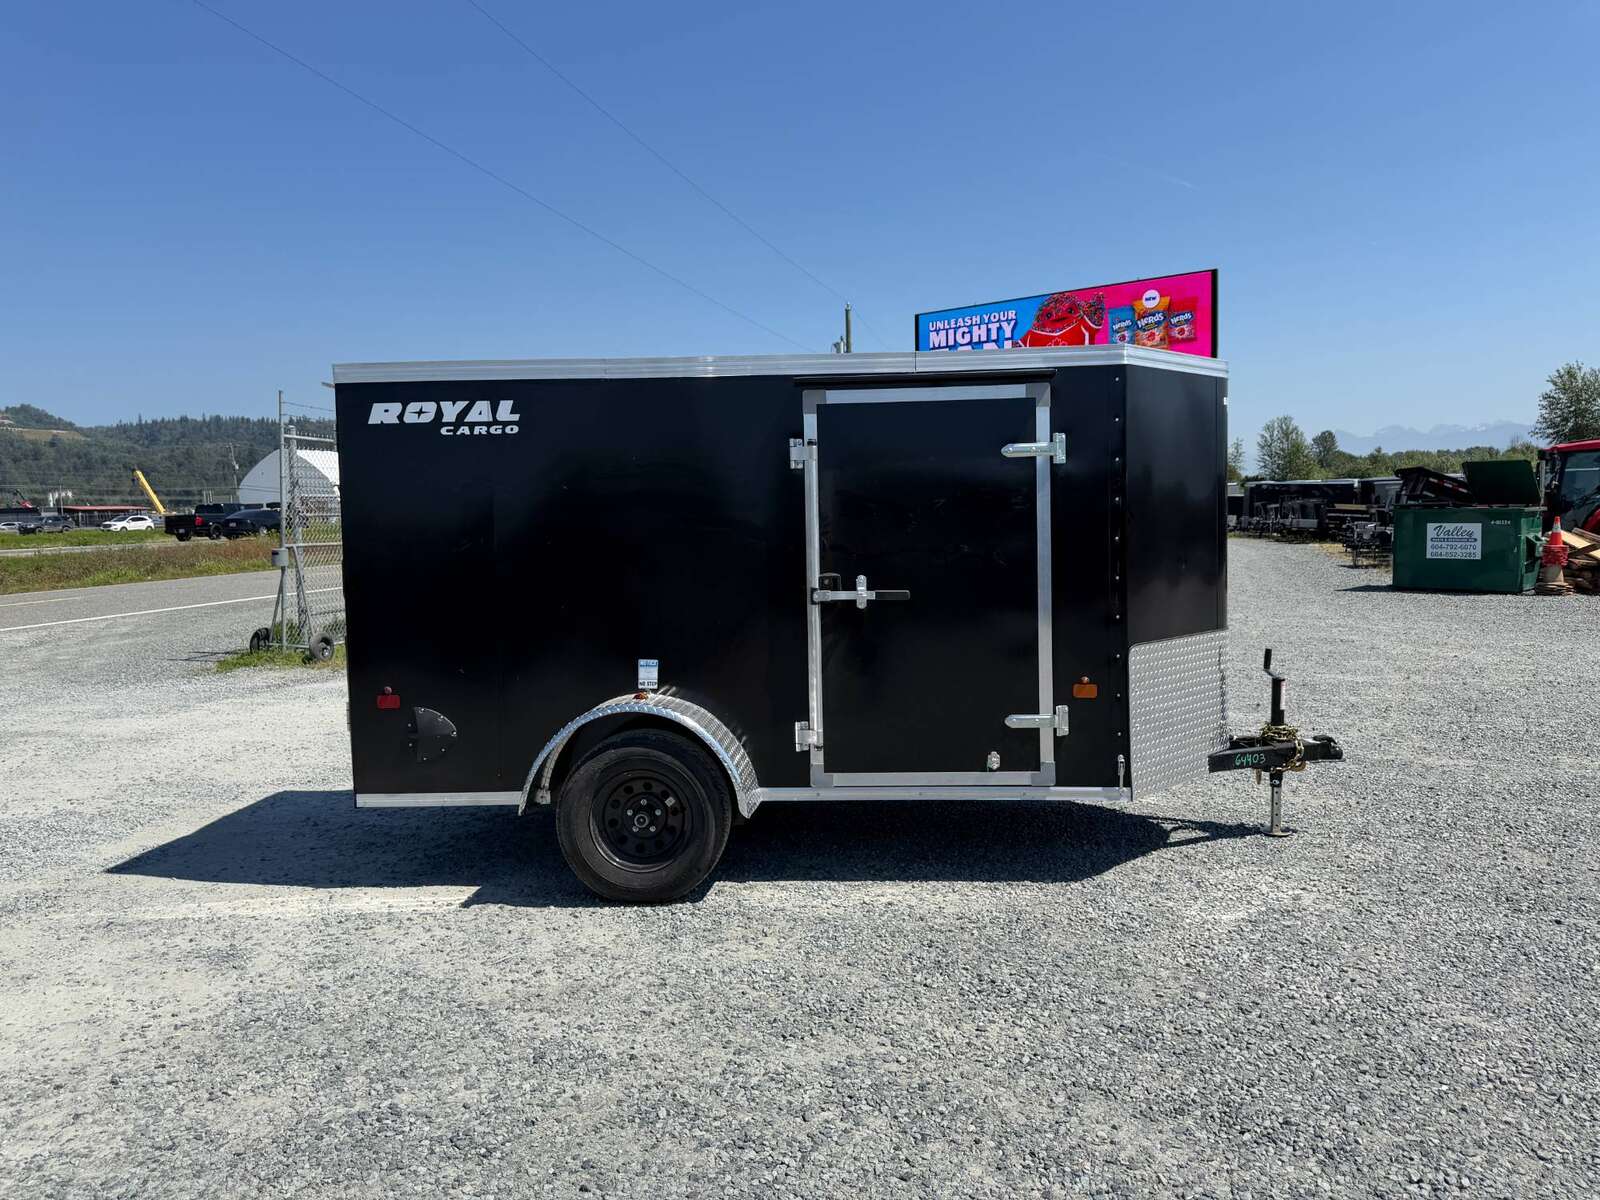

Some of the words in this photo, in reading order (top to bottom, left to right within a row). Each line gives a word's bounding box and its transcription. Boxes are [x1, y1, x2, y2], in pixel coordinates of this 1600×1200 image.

[929, 315, 980, 331] UNLEASH
[983, 310, 1016, 323] YOUR
[929, 320, 1016, 348] MIGHTY
[367, 400, 521, 425] ROYAL
[440, 425, 519, 435] CARGO
[1433, 525, 1474, 537] Valley
[1235, 753, 1266, 767] 64403
